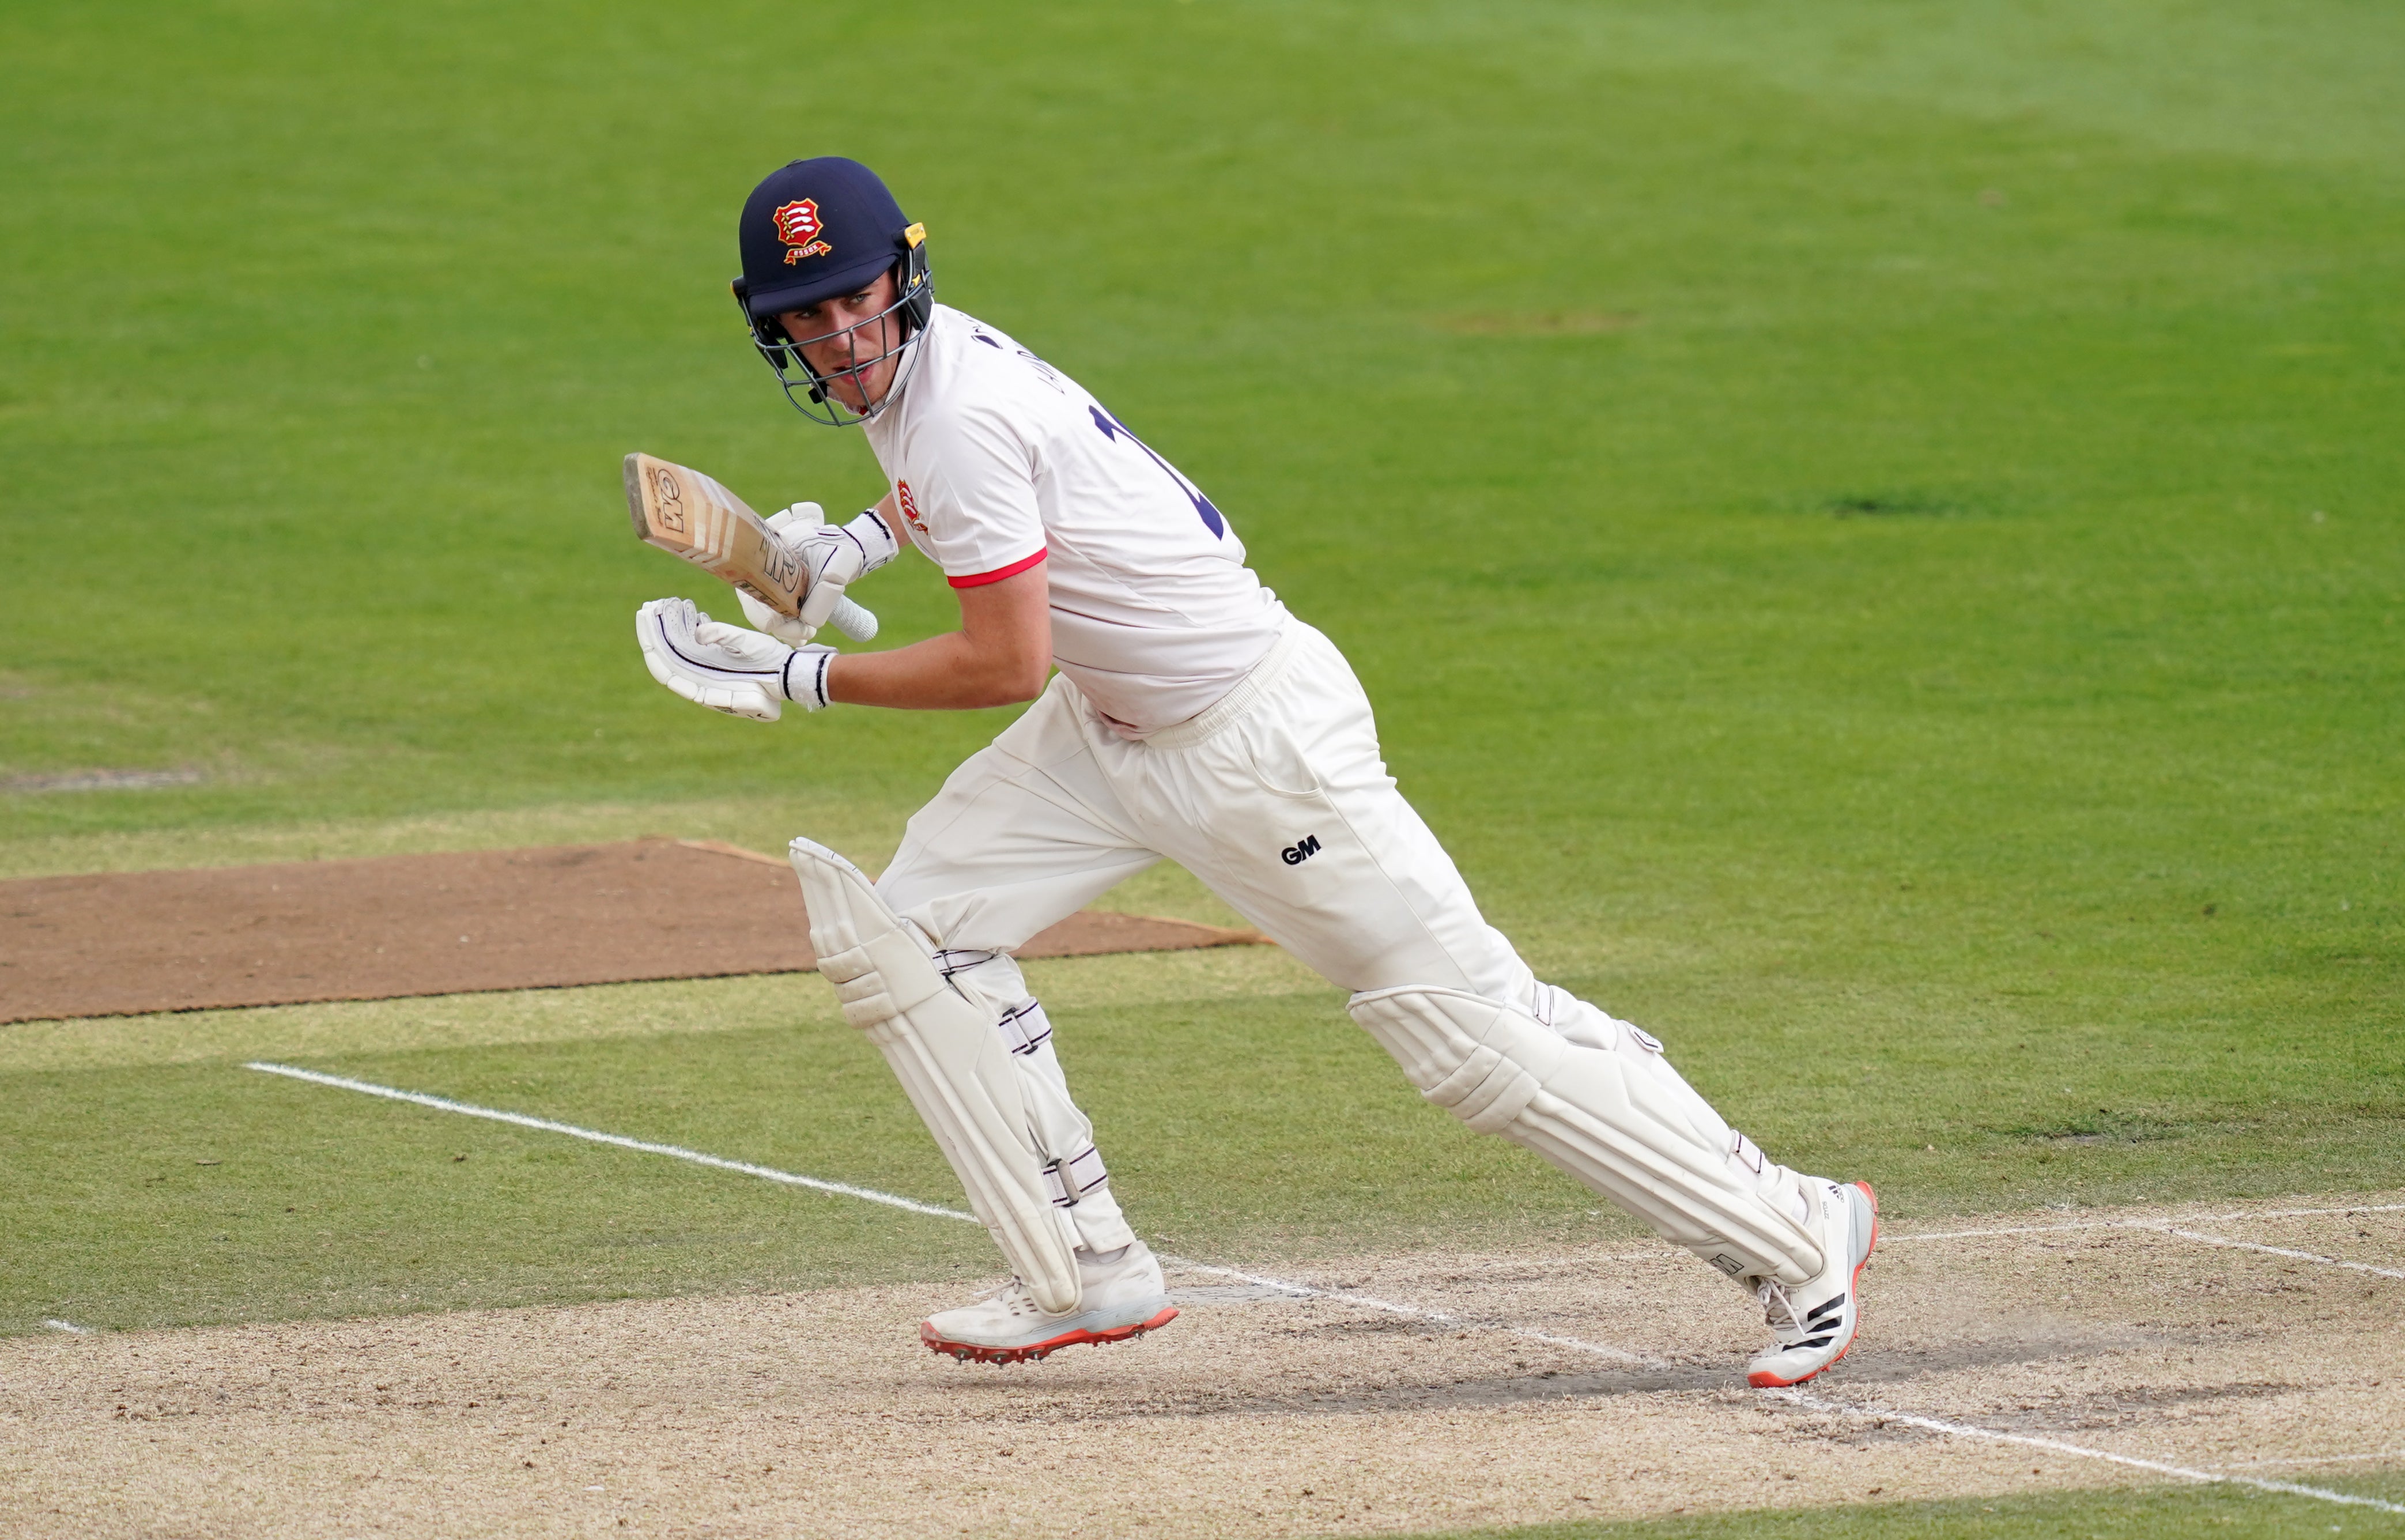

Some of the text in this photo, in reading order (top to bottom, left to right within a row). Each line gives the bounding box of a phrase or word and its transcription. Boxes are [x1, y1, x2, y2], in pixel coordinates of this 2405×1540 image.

[658, 469, 684, 534] GM
[1281, 833, 1322, 866] GM
[1709, 1252, 1745, 1275] M
